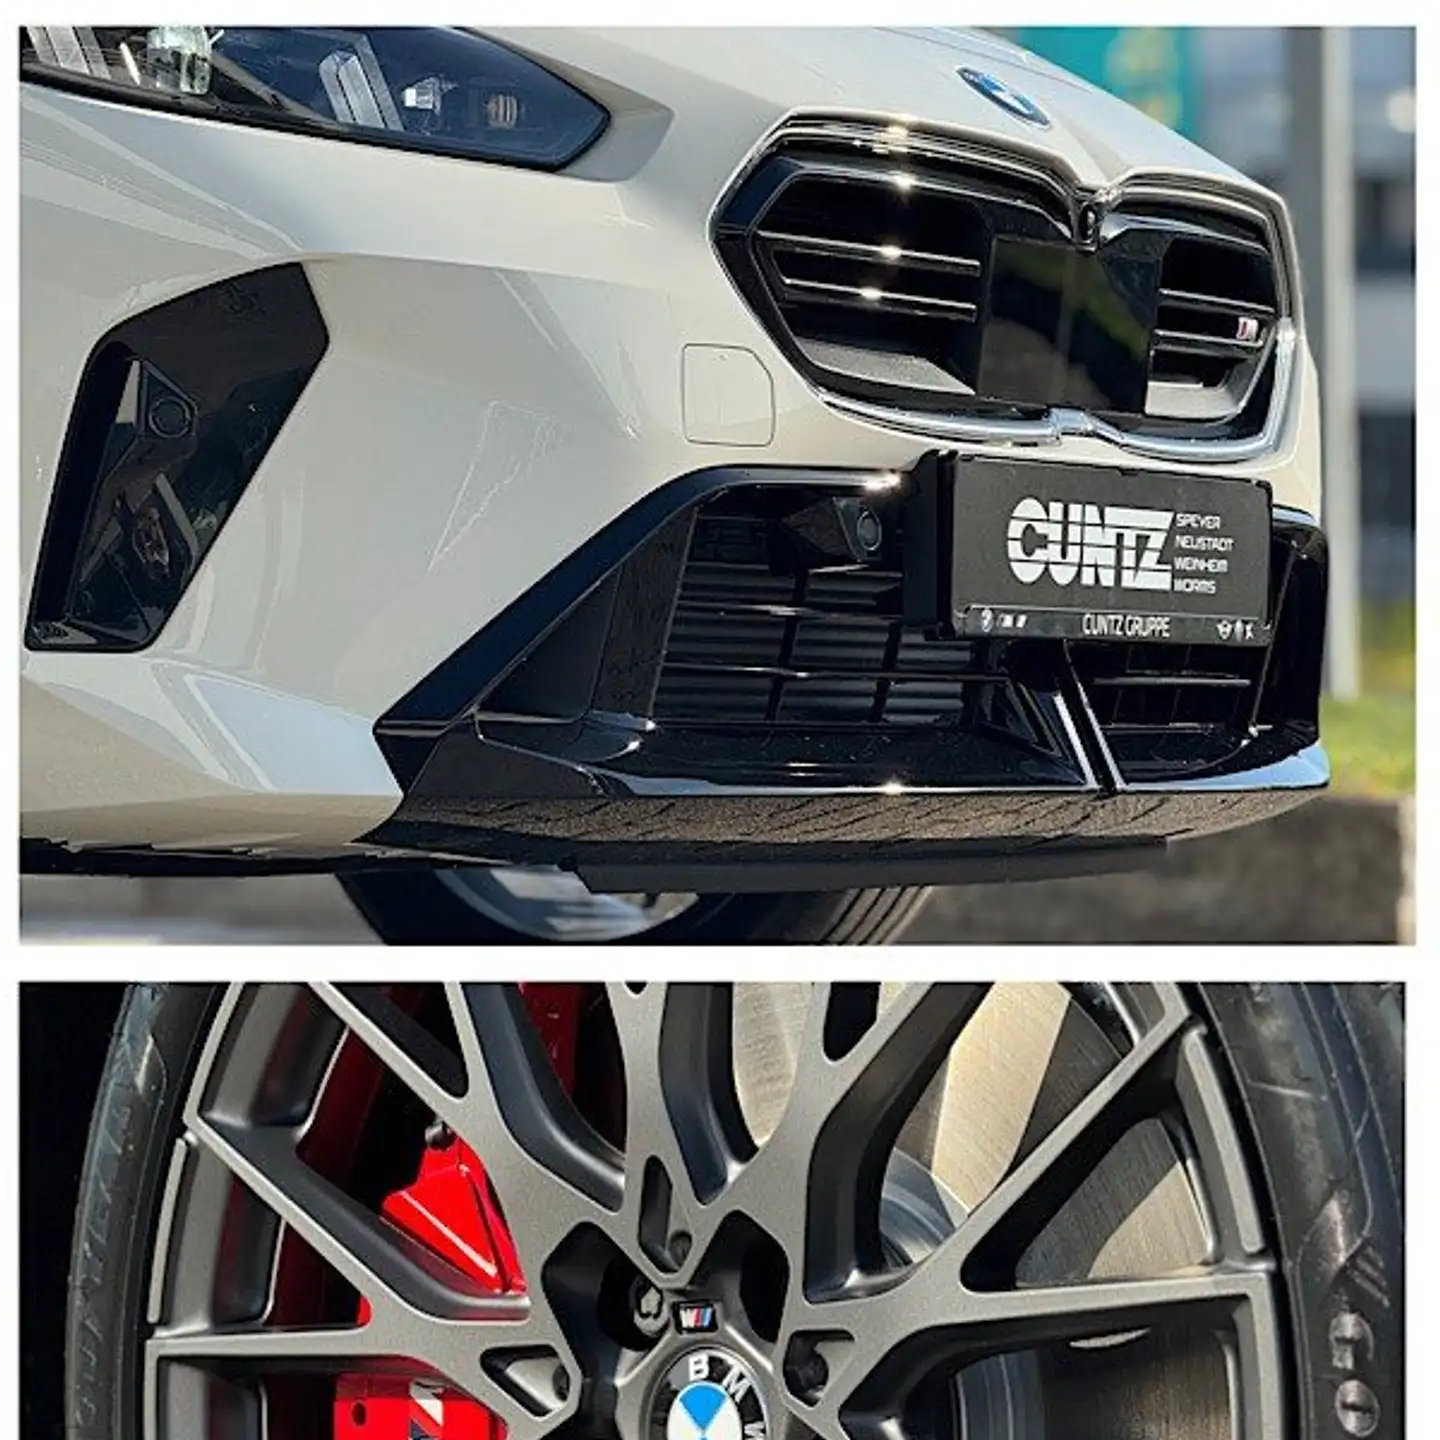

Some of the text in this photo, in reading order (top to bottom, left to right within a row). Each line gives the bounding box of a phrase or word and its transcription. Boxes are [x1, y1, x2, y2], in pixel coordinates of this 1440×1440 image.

[1175, 513, 1222, 530] SPEYER
[1007, 496, 1175, 592] CUNTZ
[1174, 534, 1234, 551] NEUSTADT
[1082, 612, 1172, 638] CUNTZ GRUPPE
